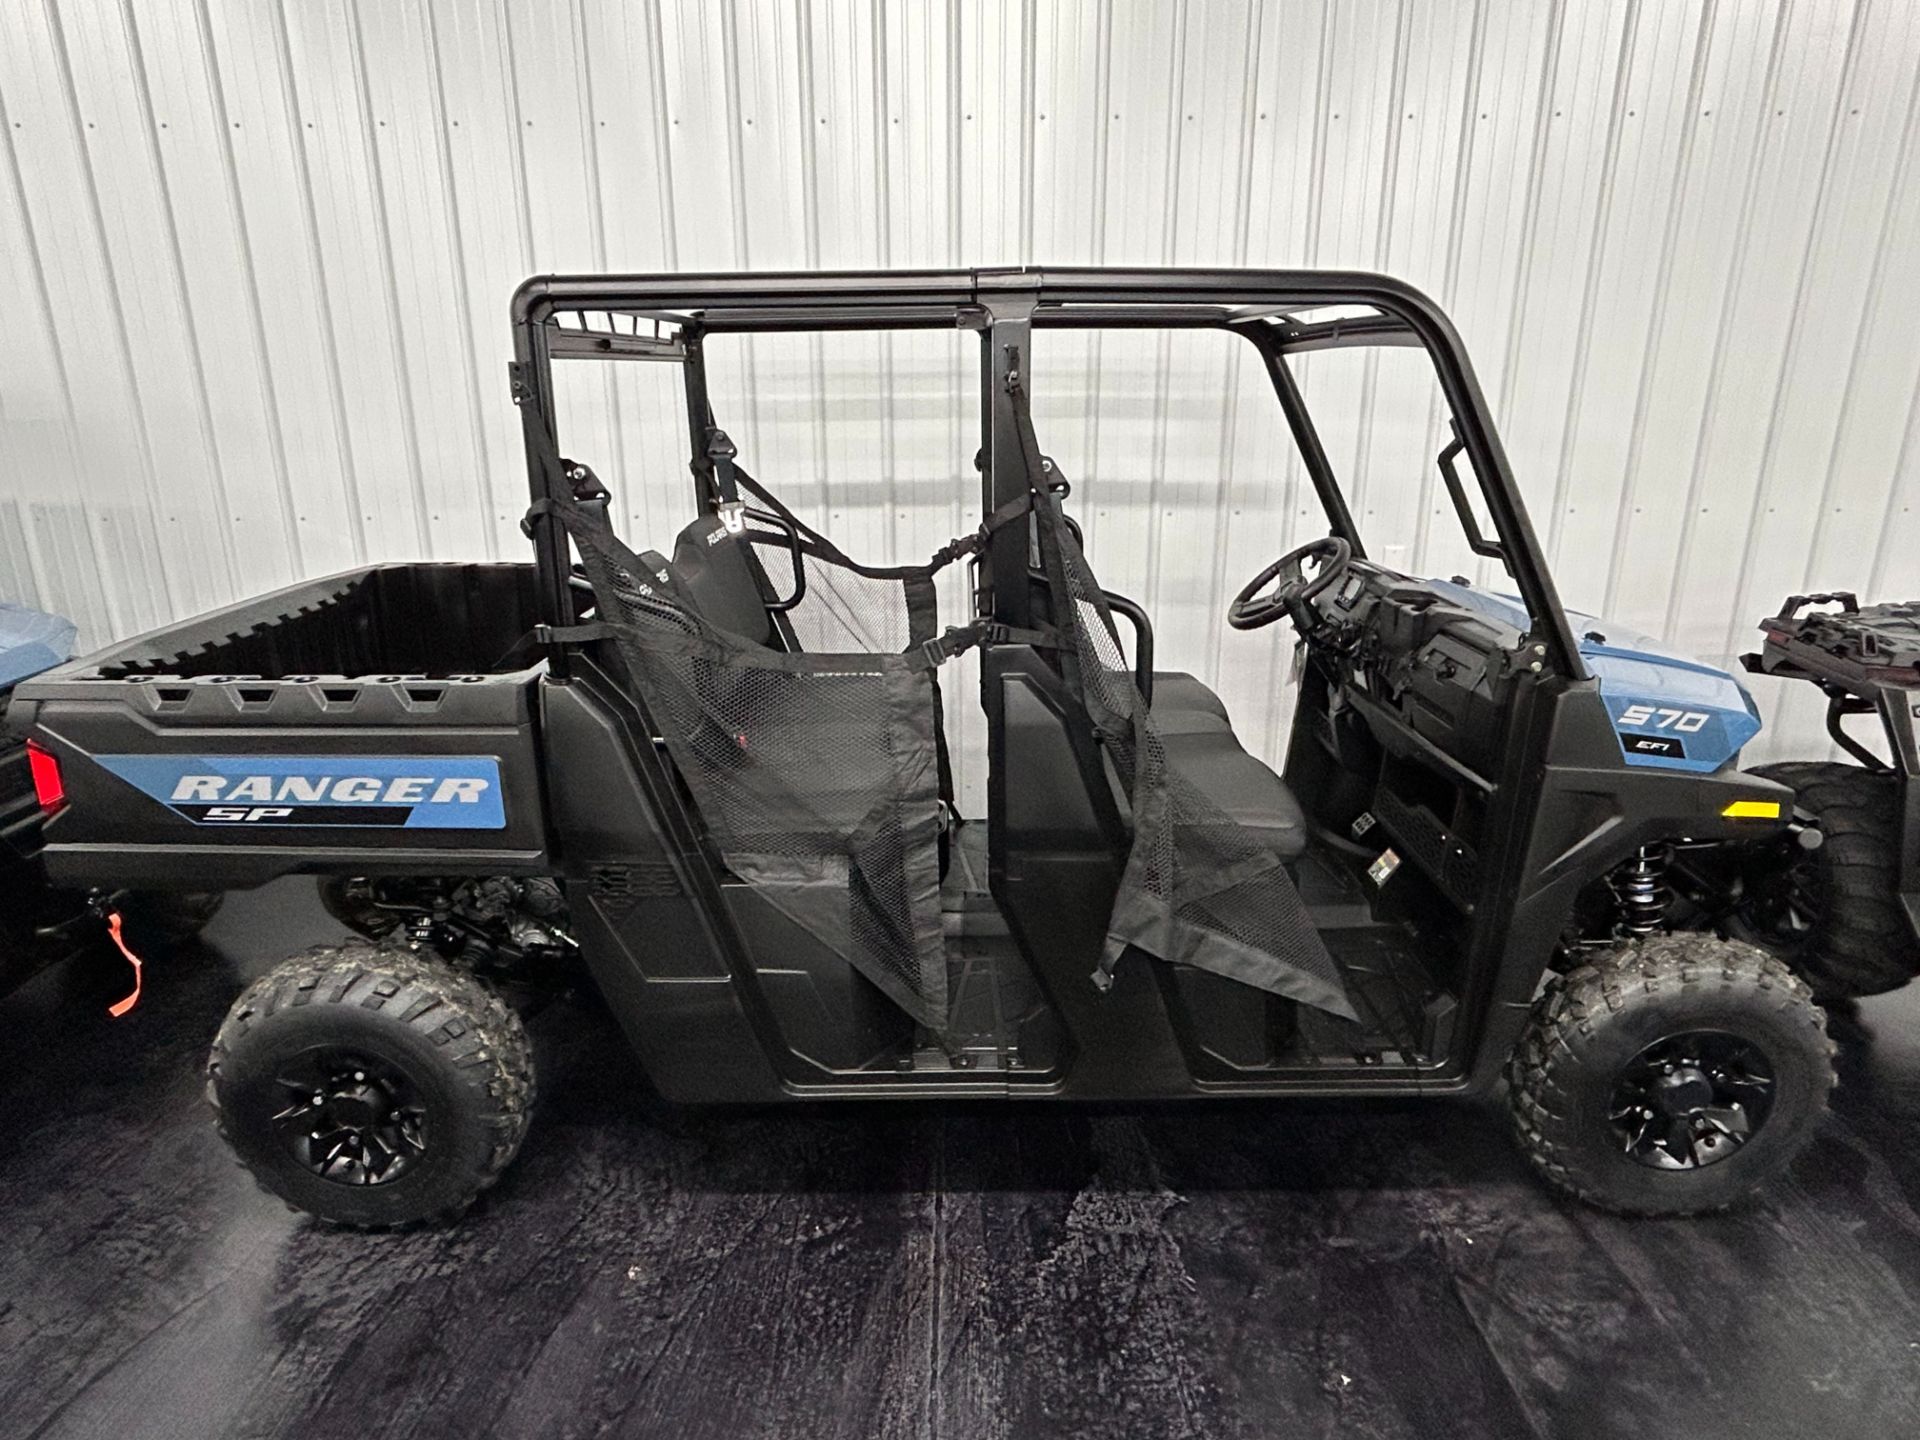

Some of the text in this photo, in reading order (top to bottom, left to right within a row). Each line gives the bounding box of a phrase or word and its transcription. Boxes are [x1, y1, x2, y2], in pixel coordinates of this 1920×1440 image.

[1617, 705, 1710, 732] 570
[1635, 740, 1670, 751] EFI
[170, 775, 489, 803] RANGER
[202, 807, 294, 821] SP
